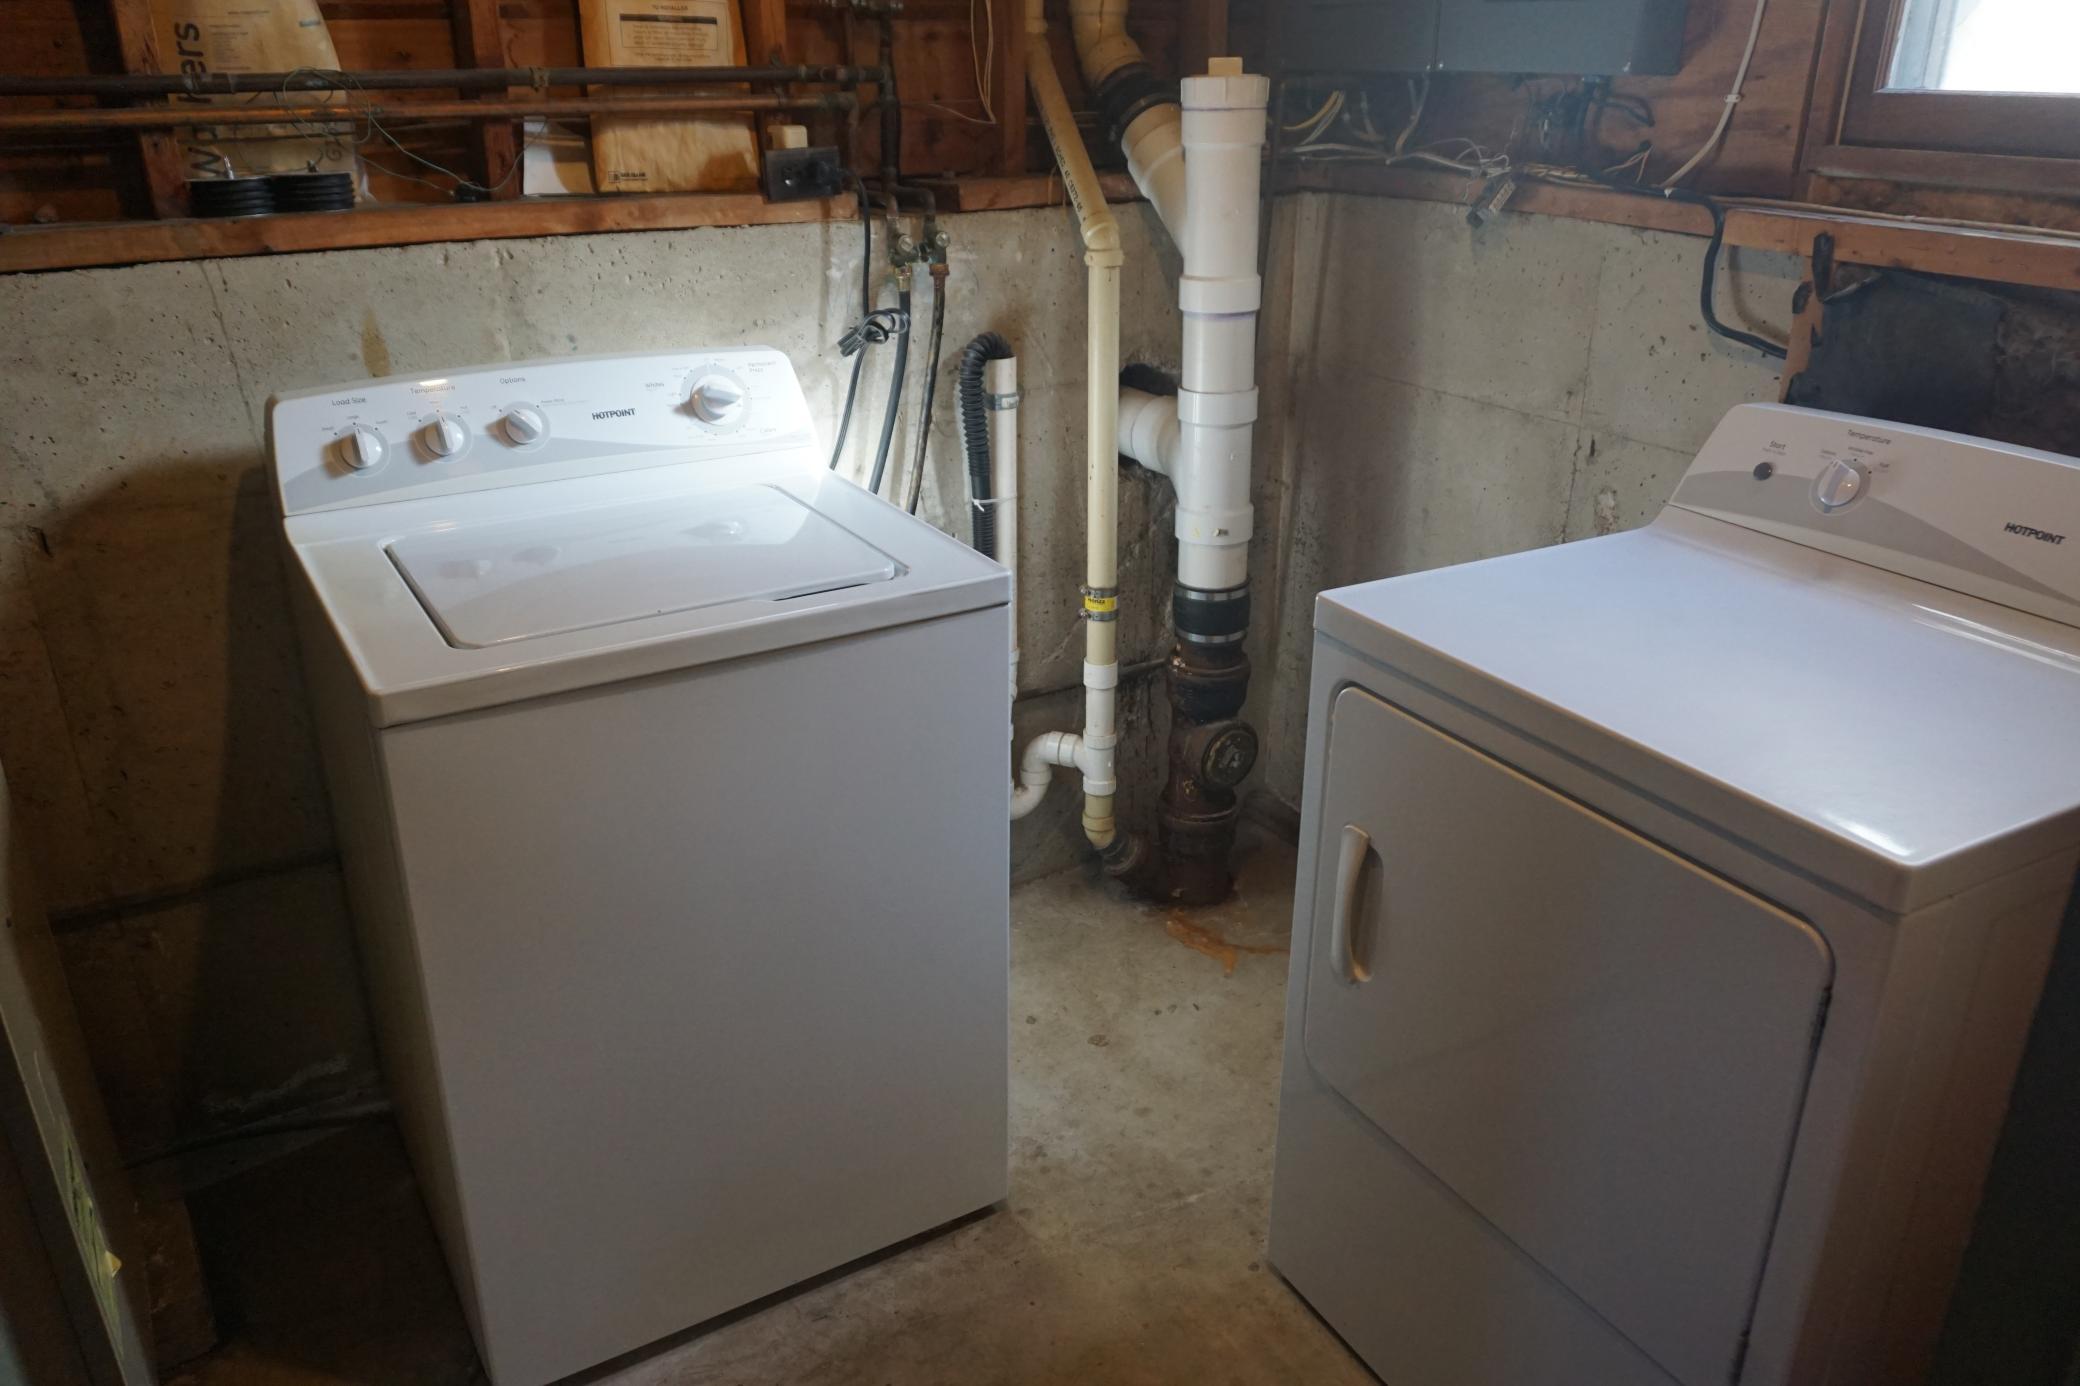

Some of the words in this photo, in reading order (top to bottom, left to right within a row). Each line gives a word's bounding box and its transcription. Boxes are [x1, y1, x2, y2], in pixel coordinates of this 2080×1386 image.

[498, 376, 526, 385] Options
[409, 385, 456, 394] Temperature
[331, 398, 350, 406] Load
[351, 396, 367, 404] Size
[591, 407, 637, 421] HOTPOINT
[1847, 429, 1893, 445] Temperature
[1769, 440, 1787, 450] Start
[2003, 521, 2067, 547] HOTPOINT
